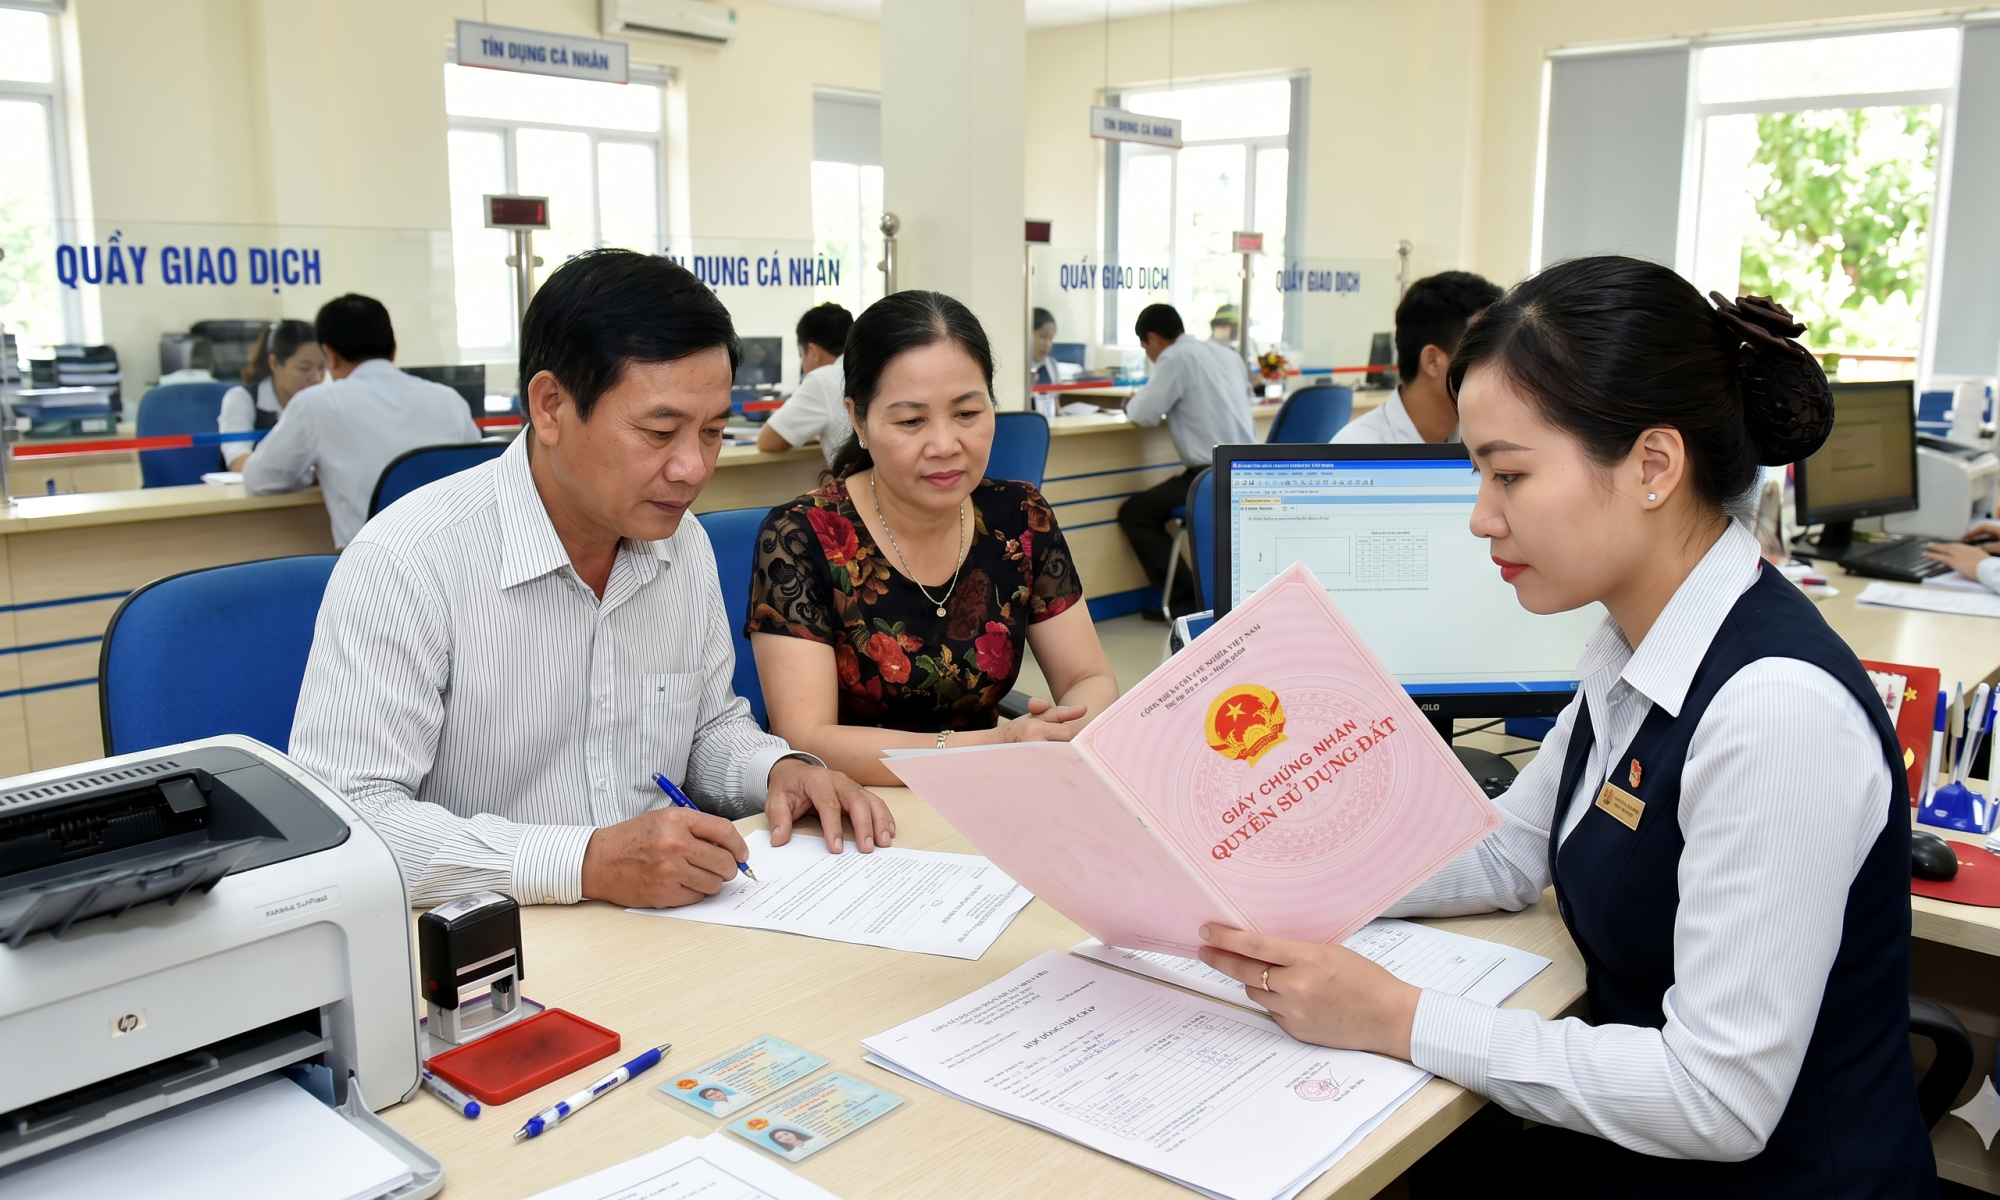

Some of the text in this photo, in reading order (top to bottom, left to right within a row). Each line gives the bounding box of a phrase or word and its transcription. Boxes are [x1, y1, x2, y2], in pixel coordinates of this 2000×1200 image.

[481, 36, 608, 71] TÍN DỤNG CÁ NHÂN
[56, 230, 322, 294] QUẦY GIAO DỊCH
[694, 255, 749, 294] DỤNG
[757, 249, 782, 287] CÁ
[789, 252, 840, 287] NHÂN
[1102, 264, 1133, 290] GIAO
[1139, 266, 1169, 296] DỊCH
[1308, 270, 1333, 292] GIAO
[1335, 271, 1360, 298] DỊCH
[1211, 715, 1397, 861] QUYỀN SỬ DỤNG ĐẤT
[1258, 752, 1314, 796] CHỨNG
